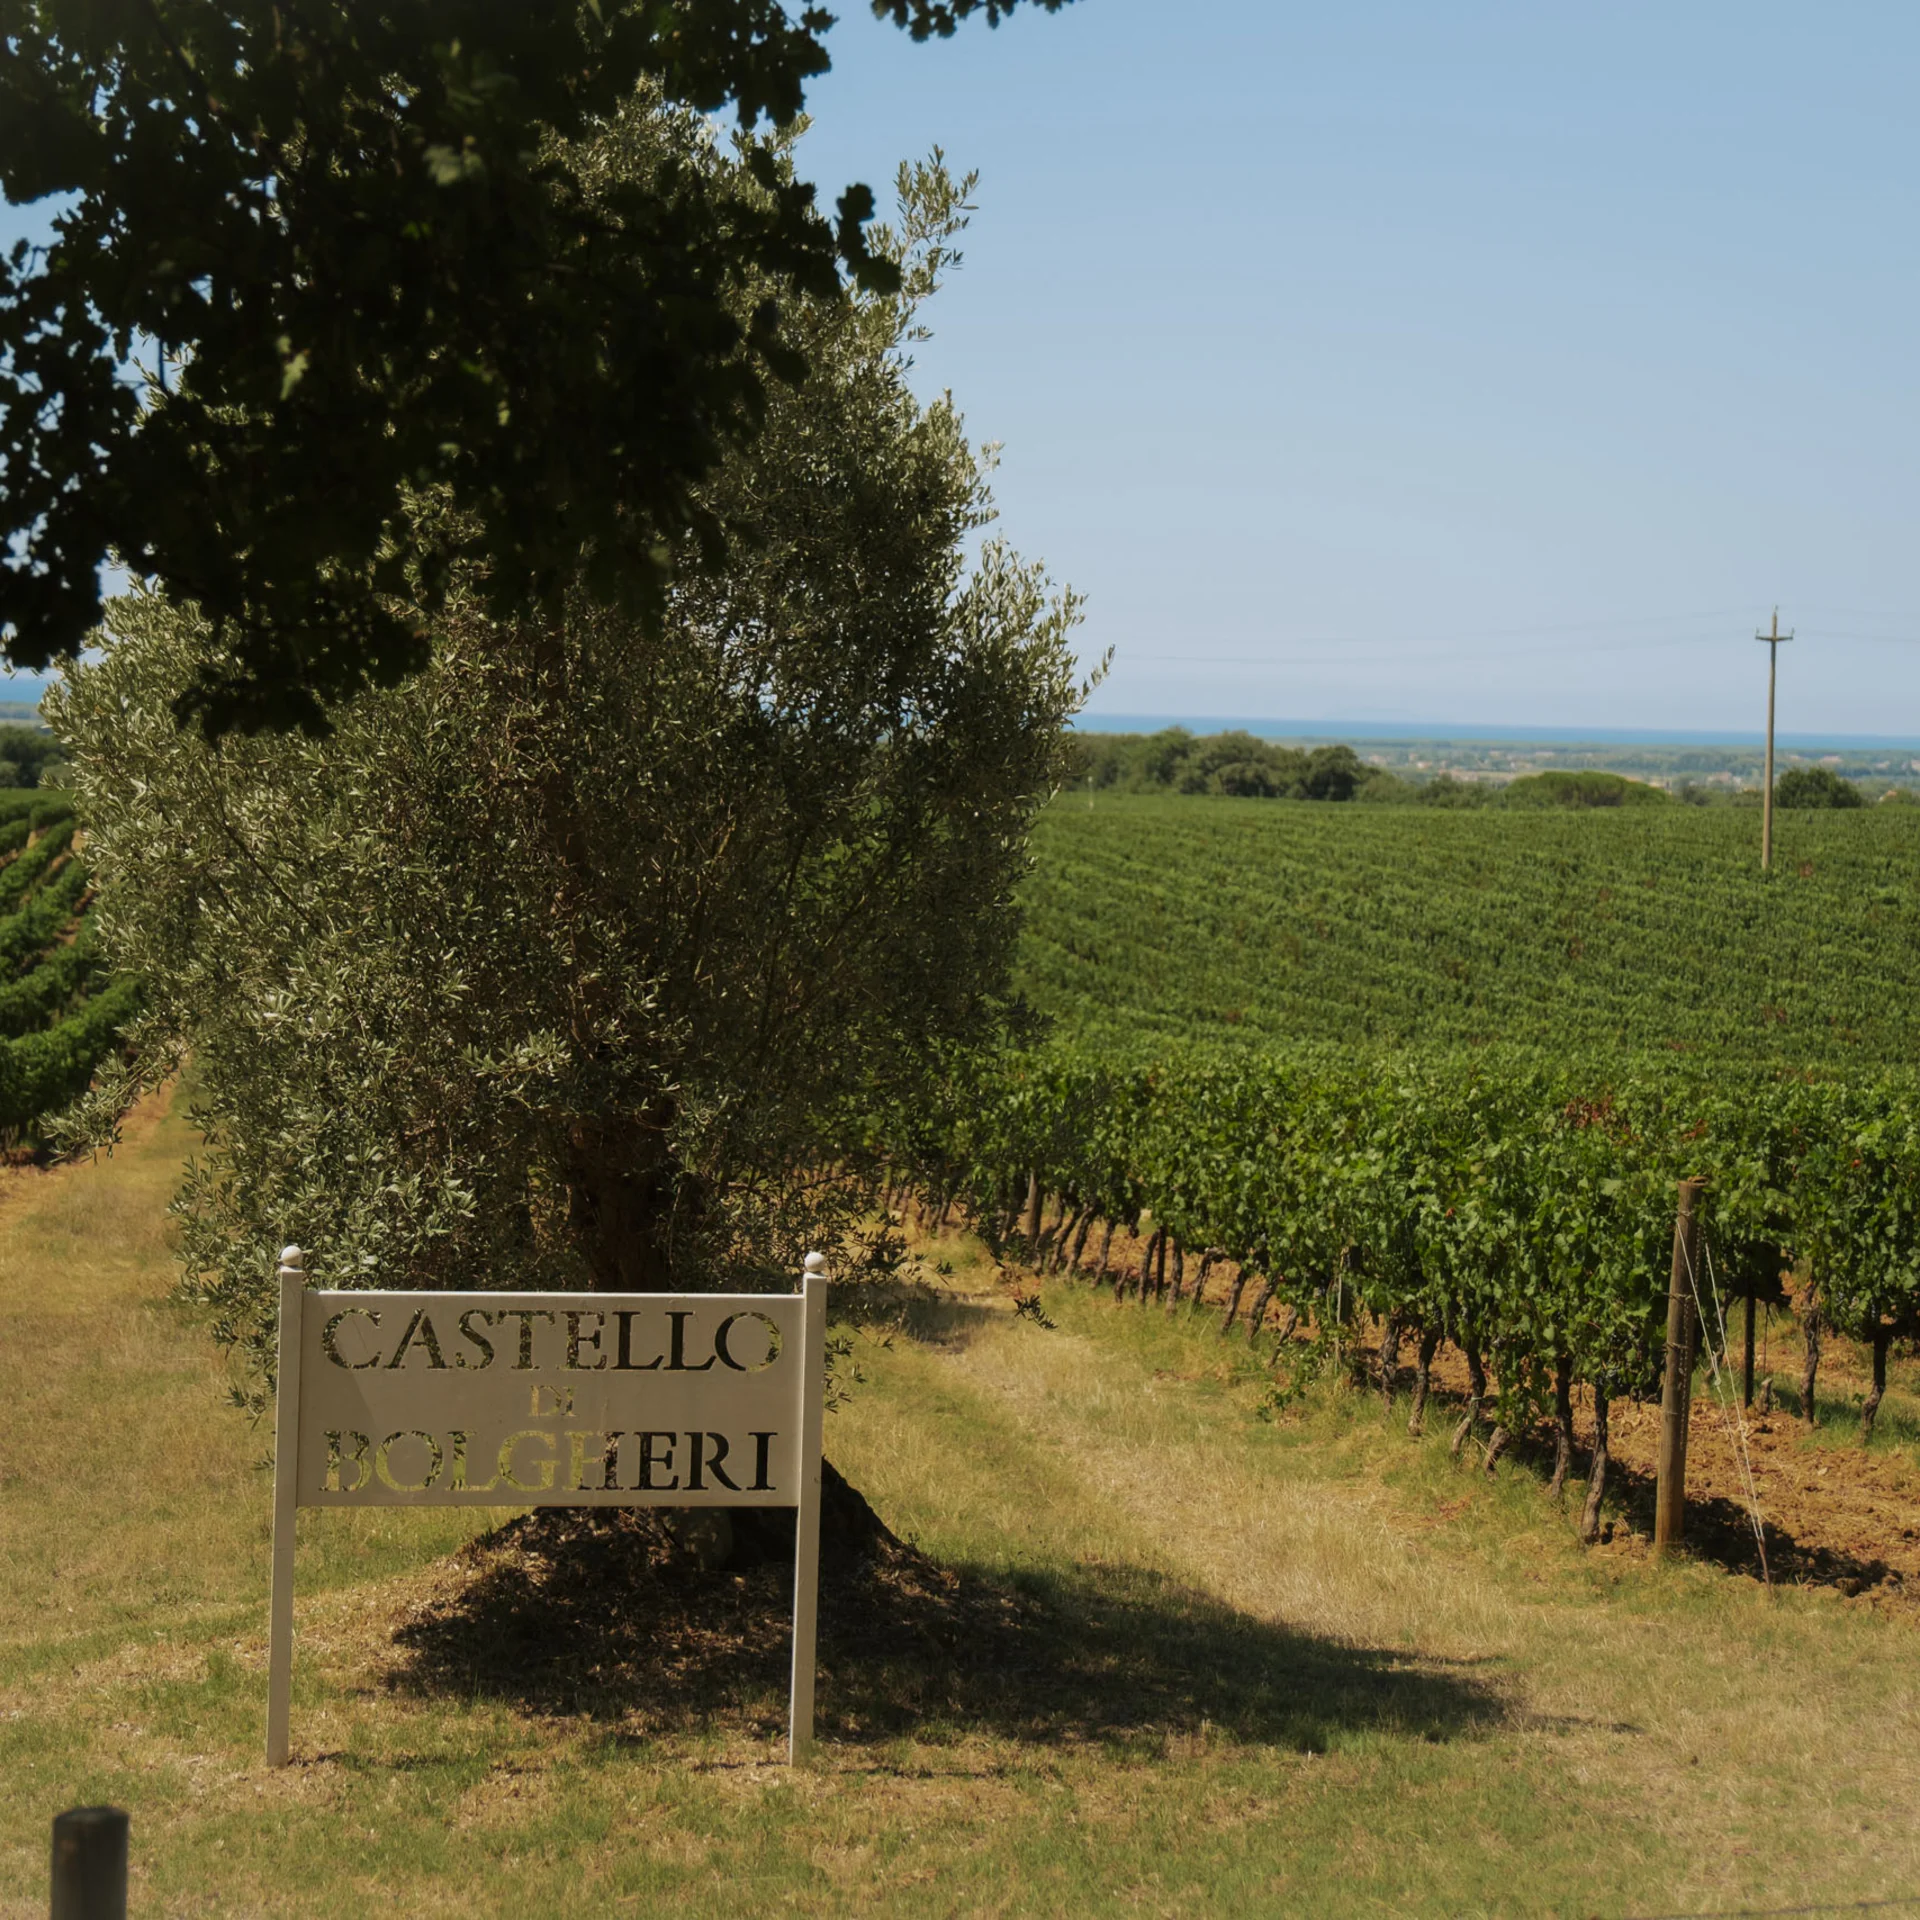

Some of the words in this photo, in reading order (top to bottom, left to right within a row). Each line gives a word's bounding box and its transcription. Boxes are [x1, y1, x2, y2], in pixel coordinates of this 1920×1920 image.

[321, 1308, 783, 1371] CASTELLO
[529, 1385, 577, 1417] DI
[319, 1431, 778, 1491] BOLGHERI
